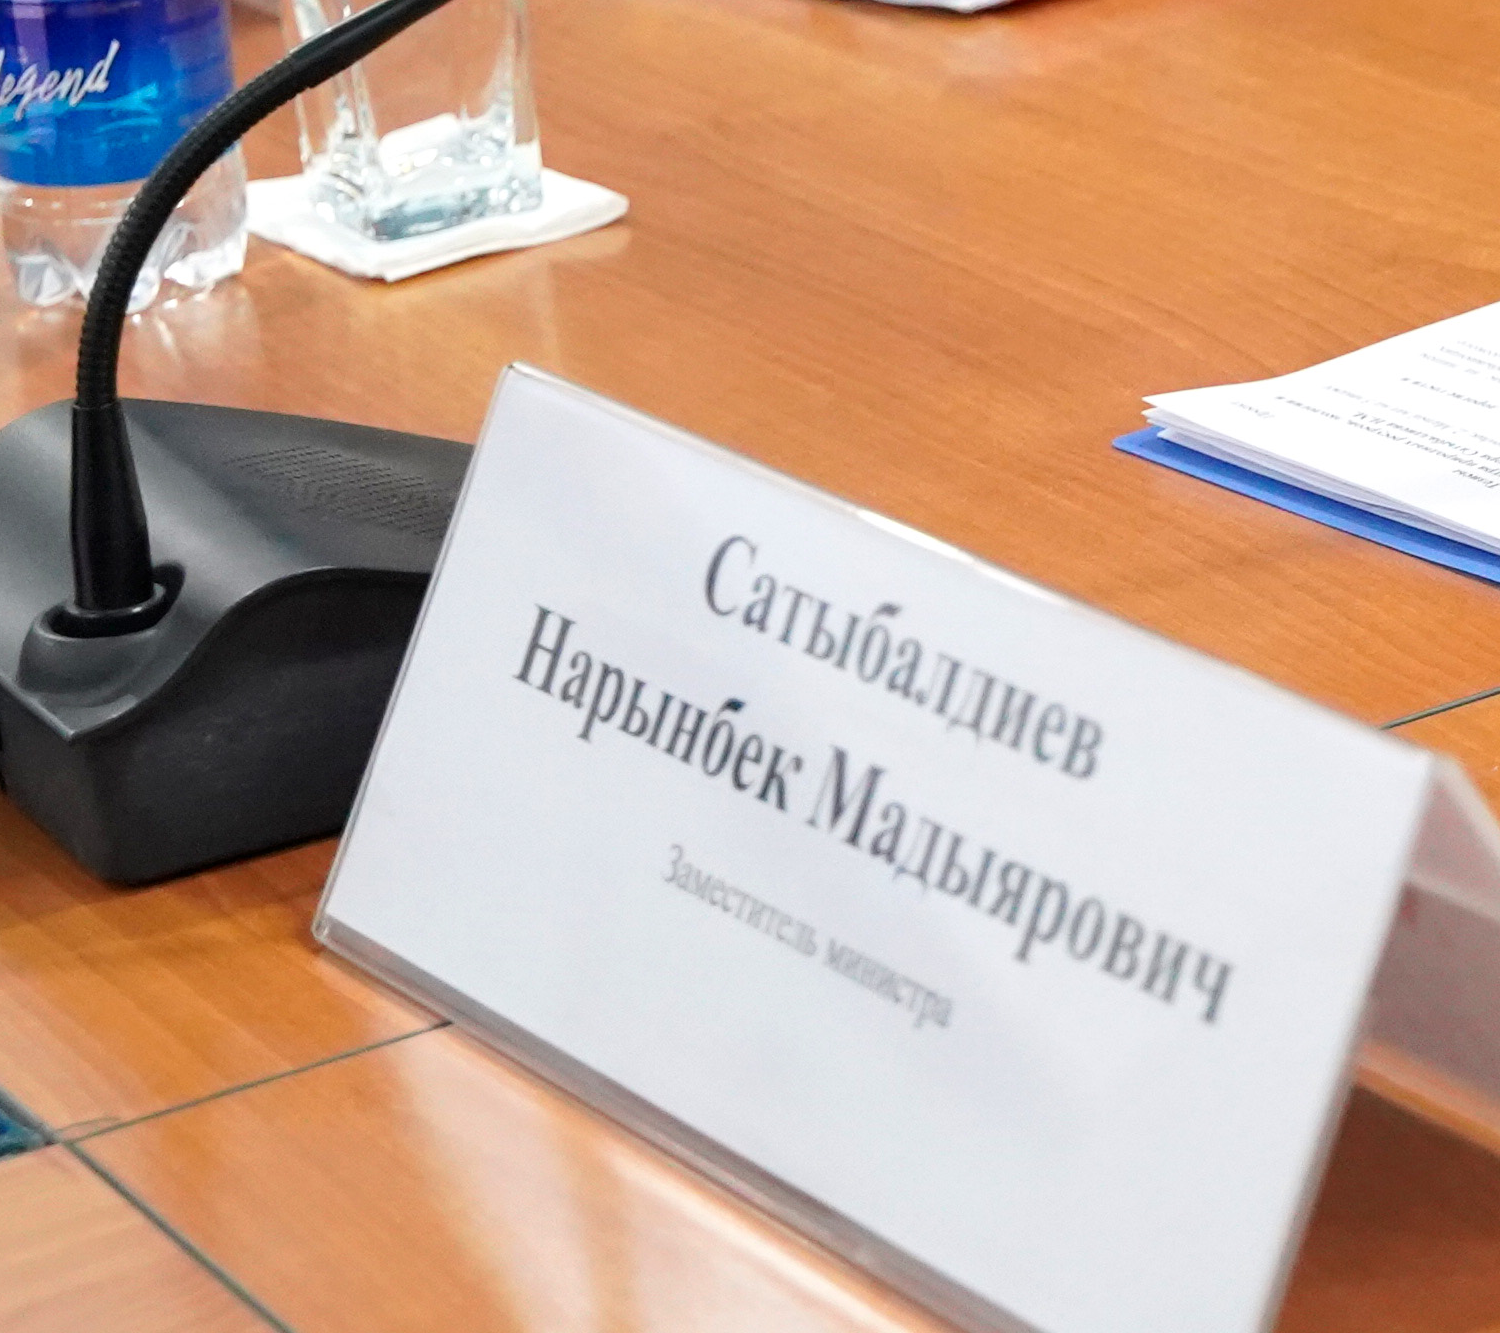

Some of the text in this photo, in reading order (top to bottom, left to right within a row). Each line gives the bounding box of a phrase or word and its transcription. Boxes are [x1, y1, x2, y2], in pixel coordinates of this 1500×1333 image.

[703, 534, 1106, 782] Сатыбалдиев
[511, 602, 1235, 1025] Нарынбек Мадыярович
[660, 843, 955, 1030] Заместитель министра
